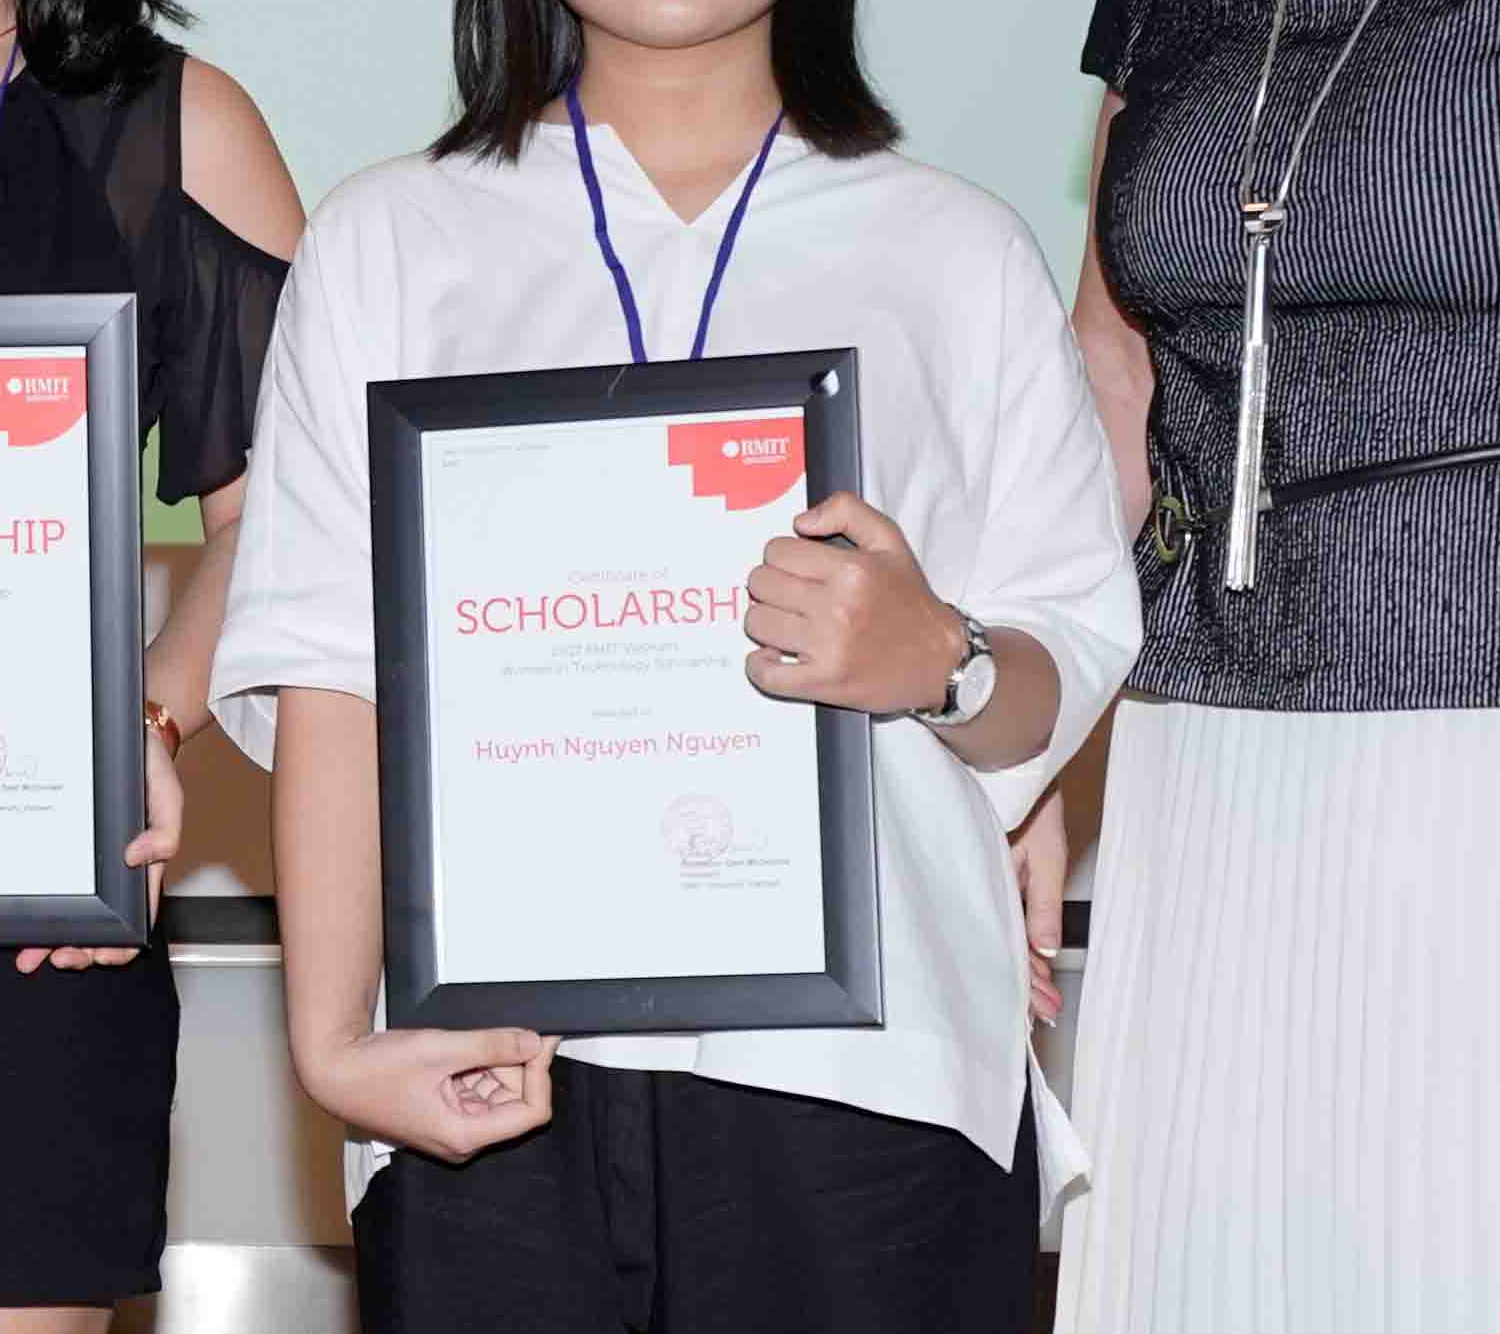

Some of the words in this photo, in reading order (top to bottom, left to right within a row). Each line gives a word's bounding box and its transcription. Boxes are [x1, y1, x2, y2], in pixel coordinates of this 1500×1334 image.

[24, 377, 71, 395] RMIT
[742, 437, 791, 455] RMIT
[456, 586, 740, 635] SCHOLARSH
[474, 738, 557, 763] Huynh
[564, 735, 657, 761] Nguyen
[665, 729, 761, 756] Nguyen
